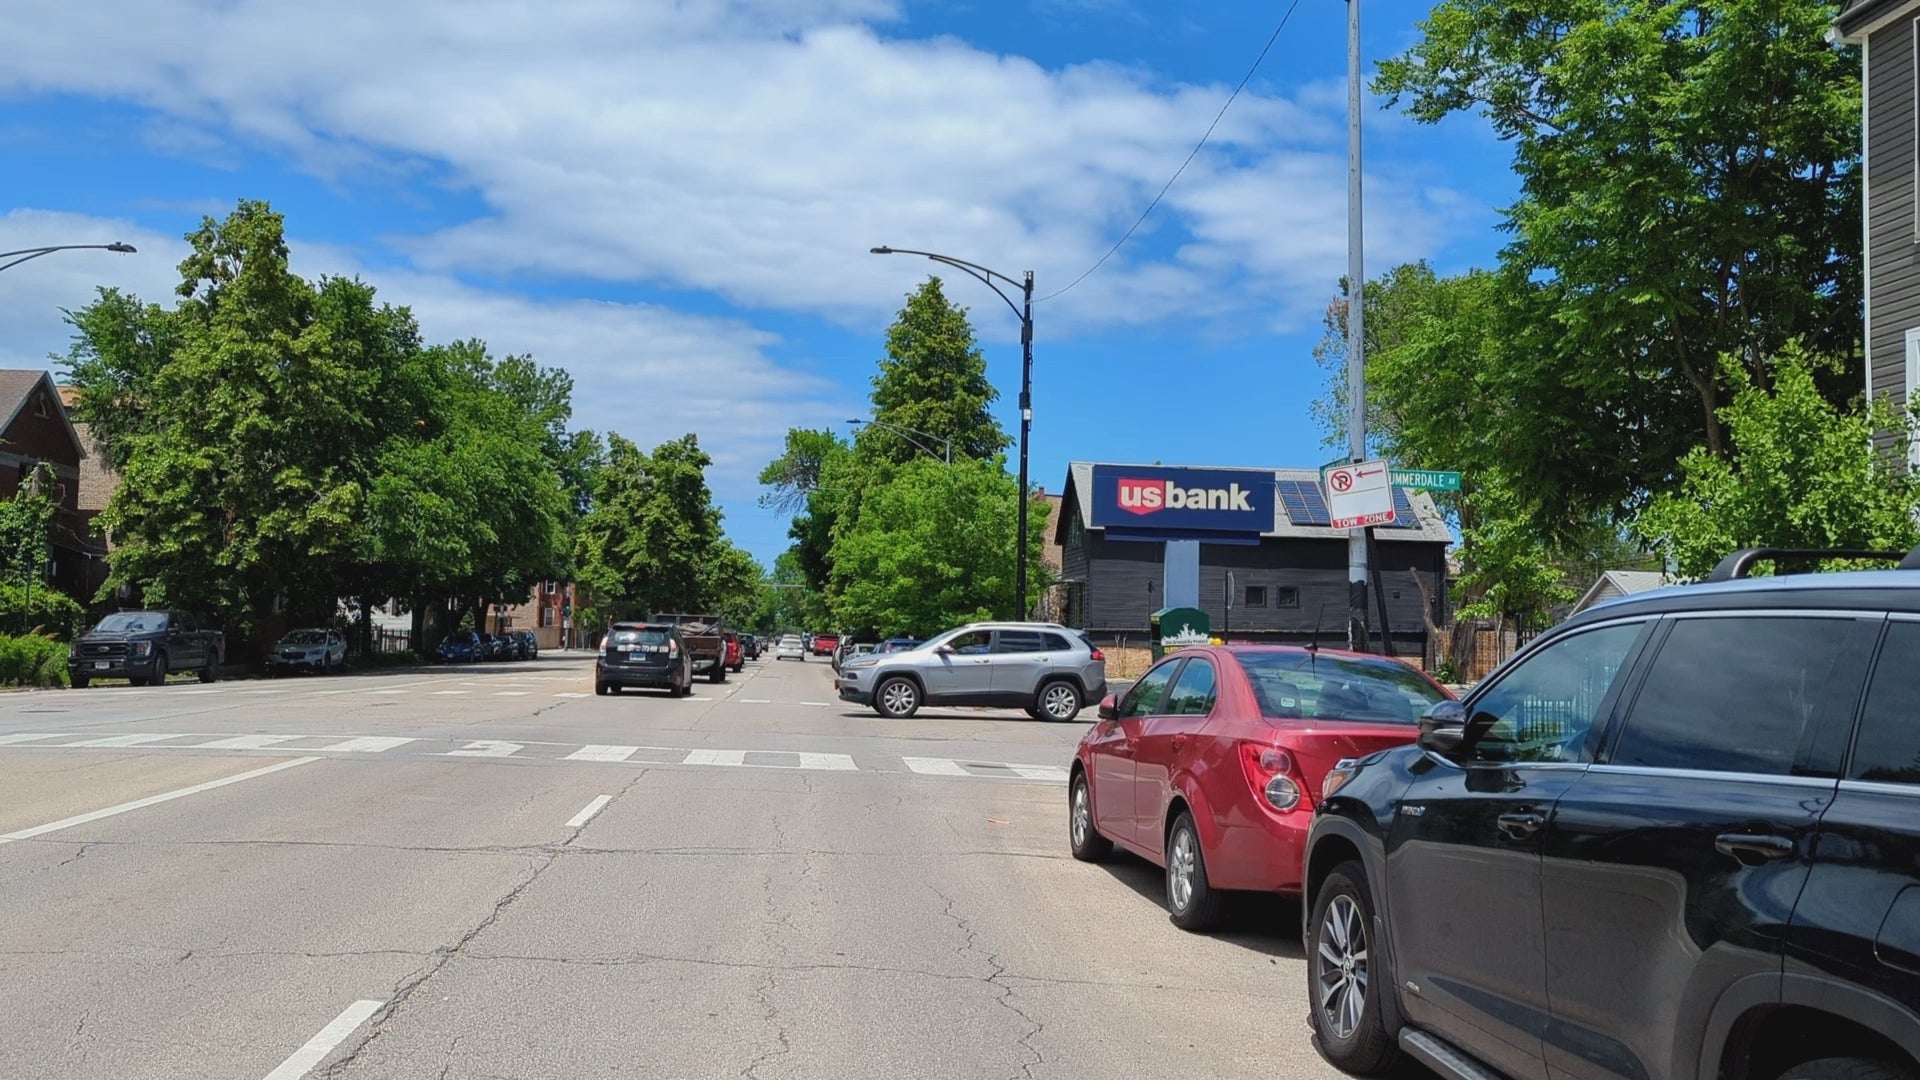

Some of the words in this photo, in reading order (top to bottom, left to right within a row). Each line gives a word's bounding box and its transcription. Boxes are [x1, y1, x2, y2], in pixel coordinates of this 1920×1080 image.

[1389, 471, 1444, 487] UMMERDALE
[1337, 518, 1358, 528] TOW
[1363, 512, 1388, 524] ZONE
